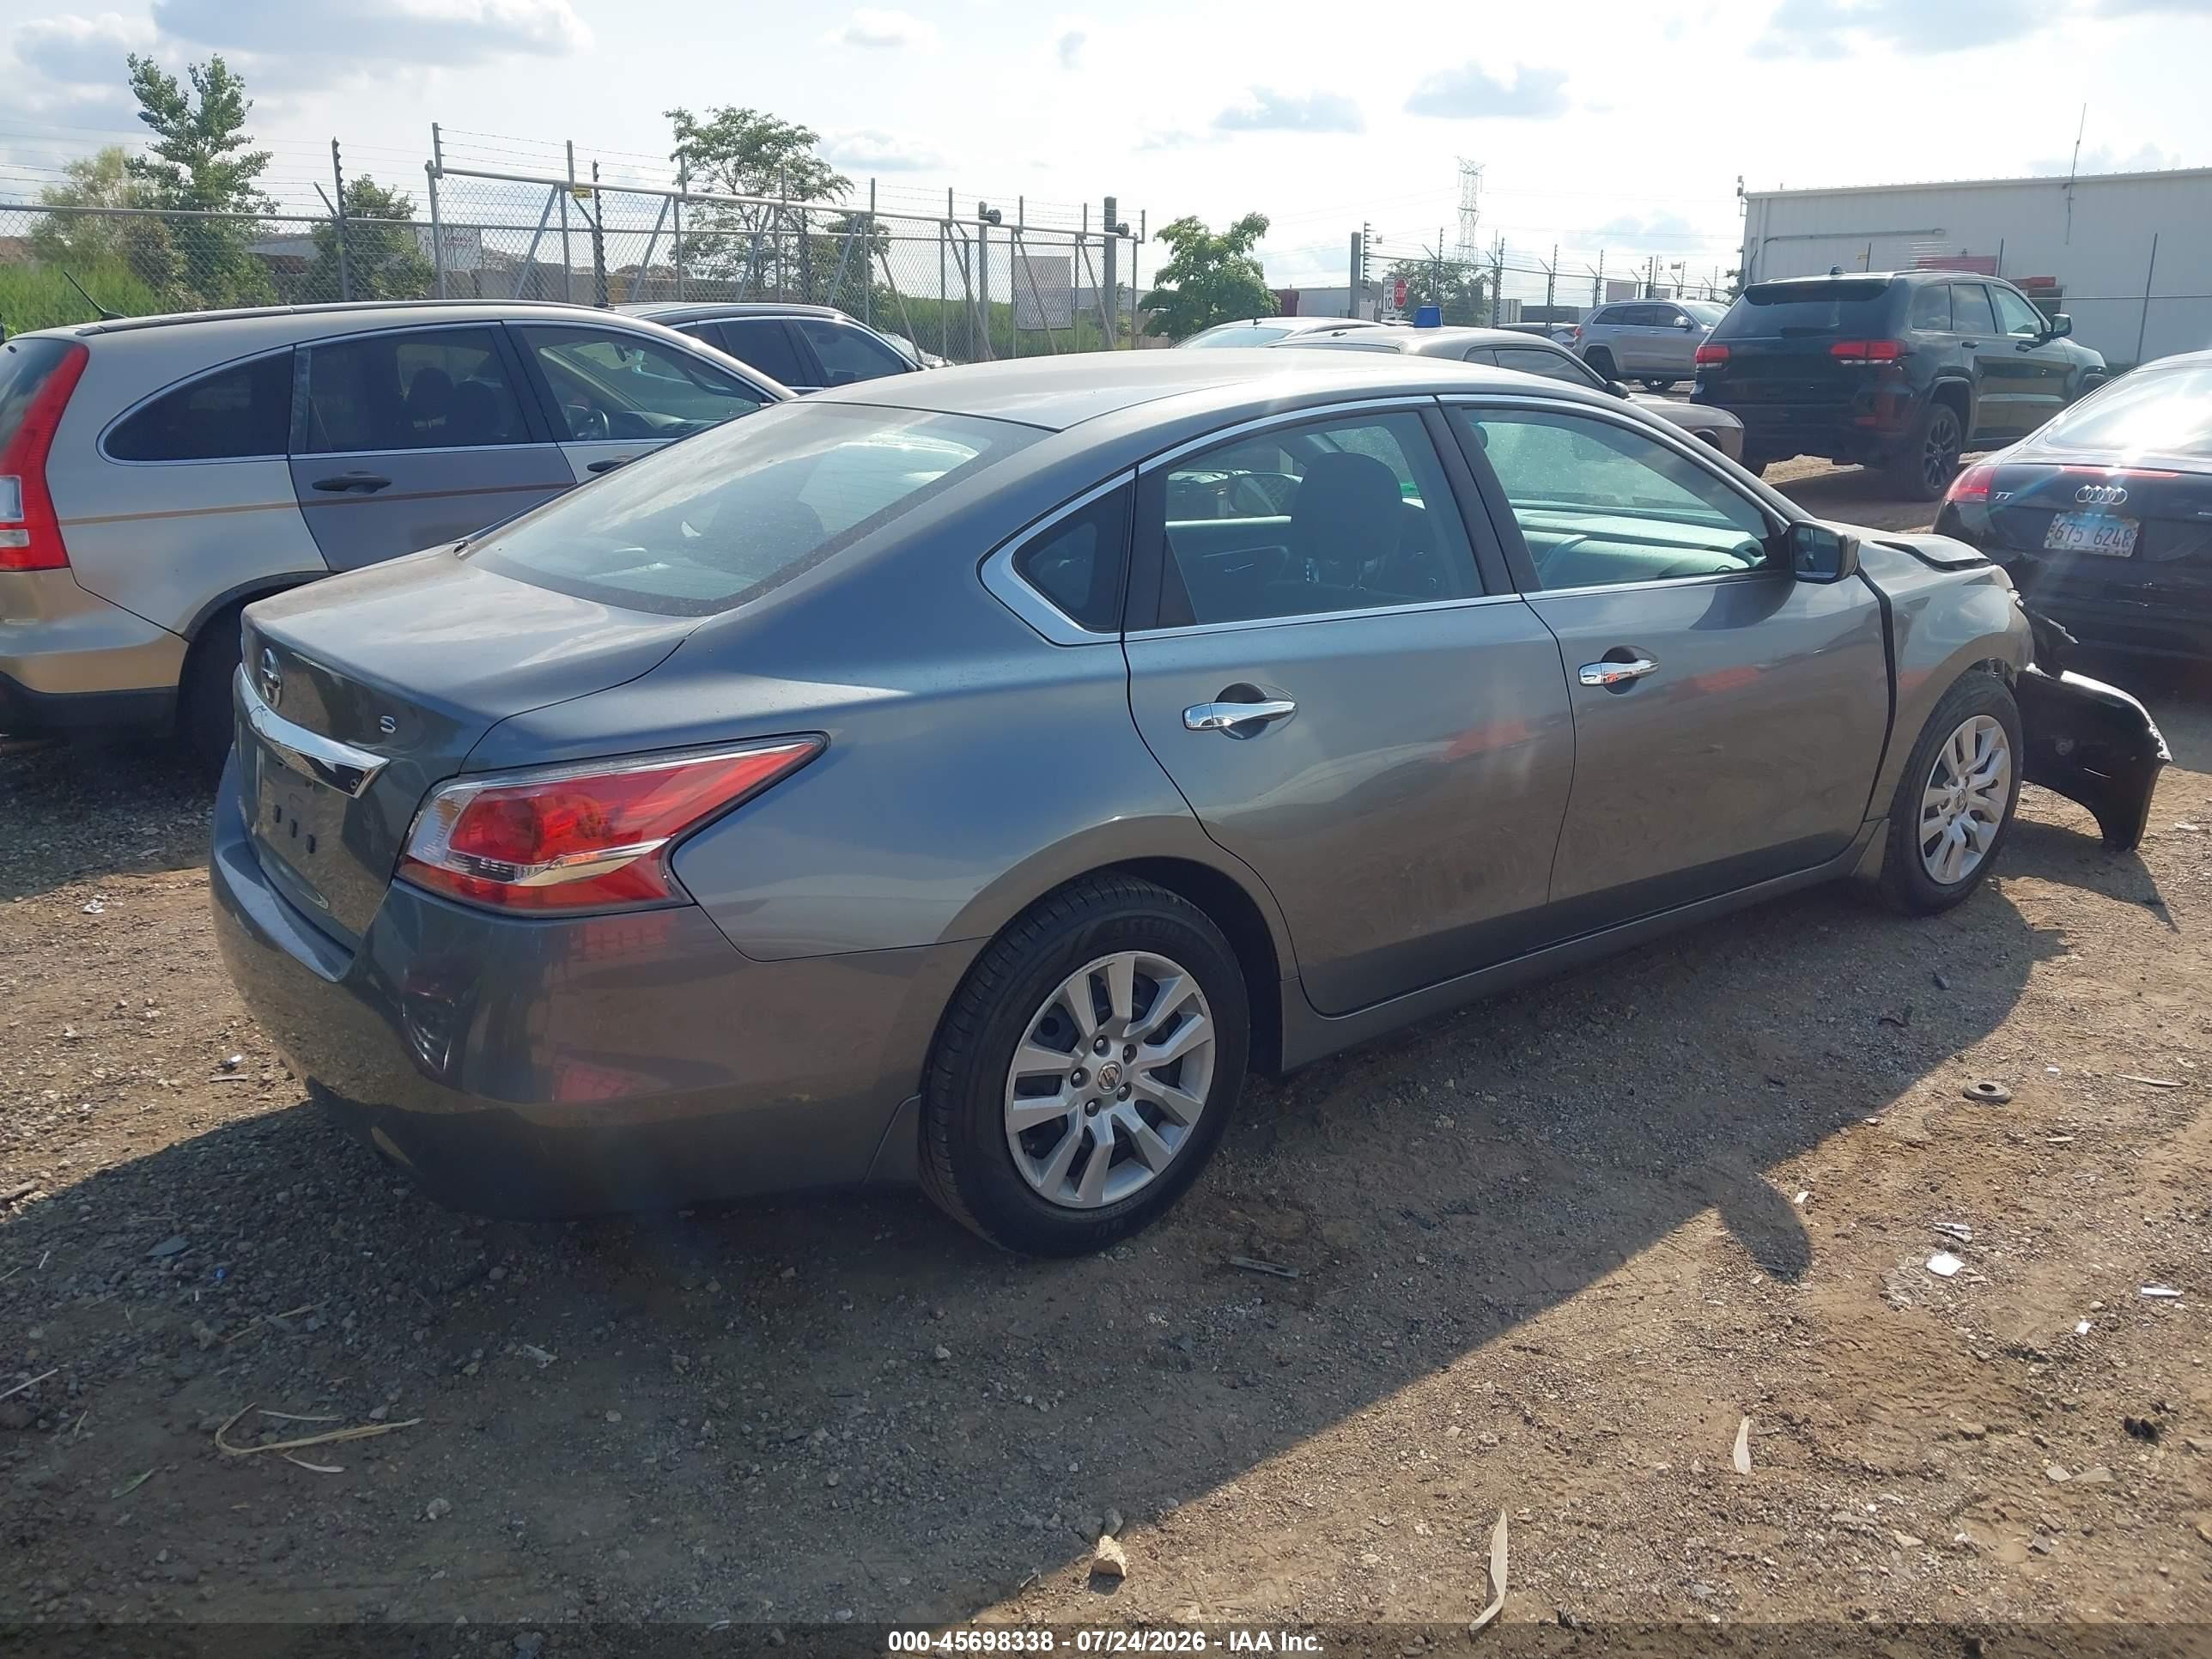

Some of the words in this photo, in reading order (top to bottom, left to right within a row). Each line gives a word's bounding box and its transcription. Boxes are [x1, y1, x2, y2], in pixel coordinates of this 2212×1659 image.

[1395, 287, 1407, 298] STOP
[1385, 297, 1393, 310] 10
[1995, 491, 2014, 500] TT
[2055, 522, 2084, 543] 675
[380, 715, 396, 733] S
